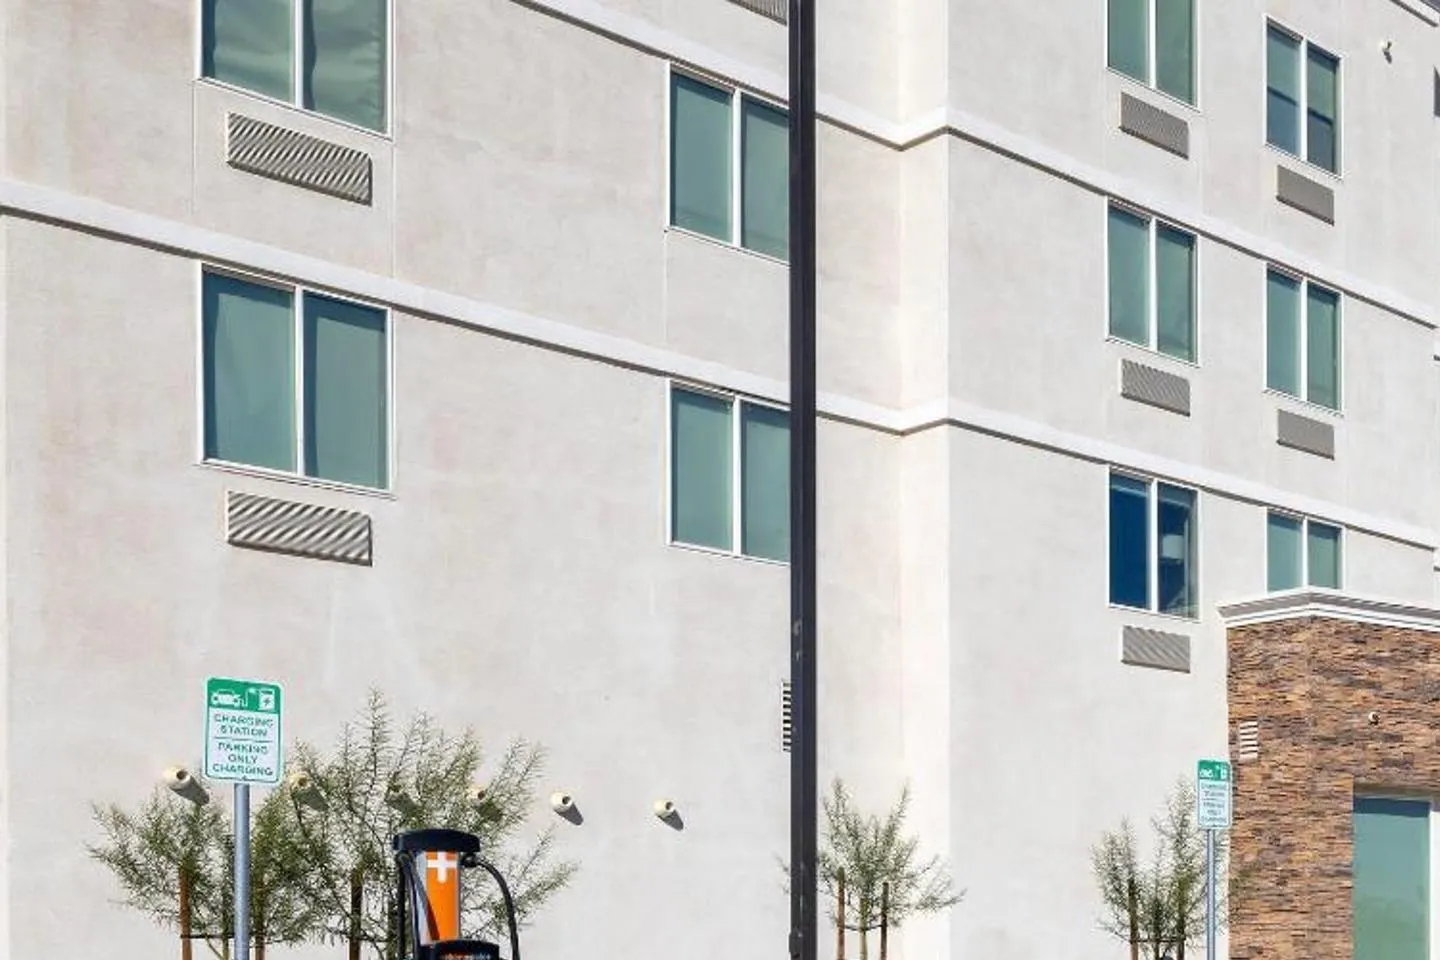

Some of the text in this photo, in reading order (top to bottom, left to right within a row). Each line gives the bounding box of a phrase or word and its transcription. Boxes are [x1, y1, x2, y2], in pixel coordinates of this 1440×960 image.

[214, 713, 273, 728] CHARGING
[220, 725, 268, 737] STATION
[218, 741, 268, 755] PARKING
[227, 753, 258, 765] ONLY
[212, 763, 273, 776] CHARGING
